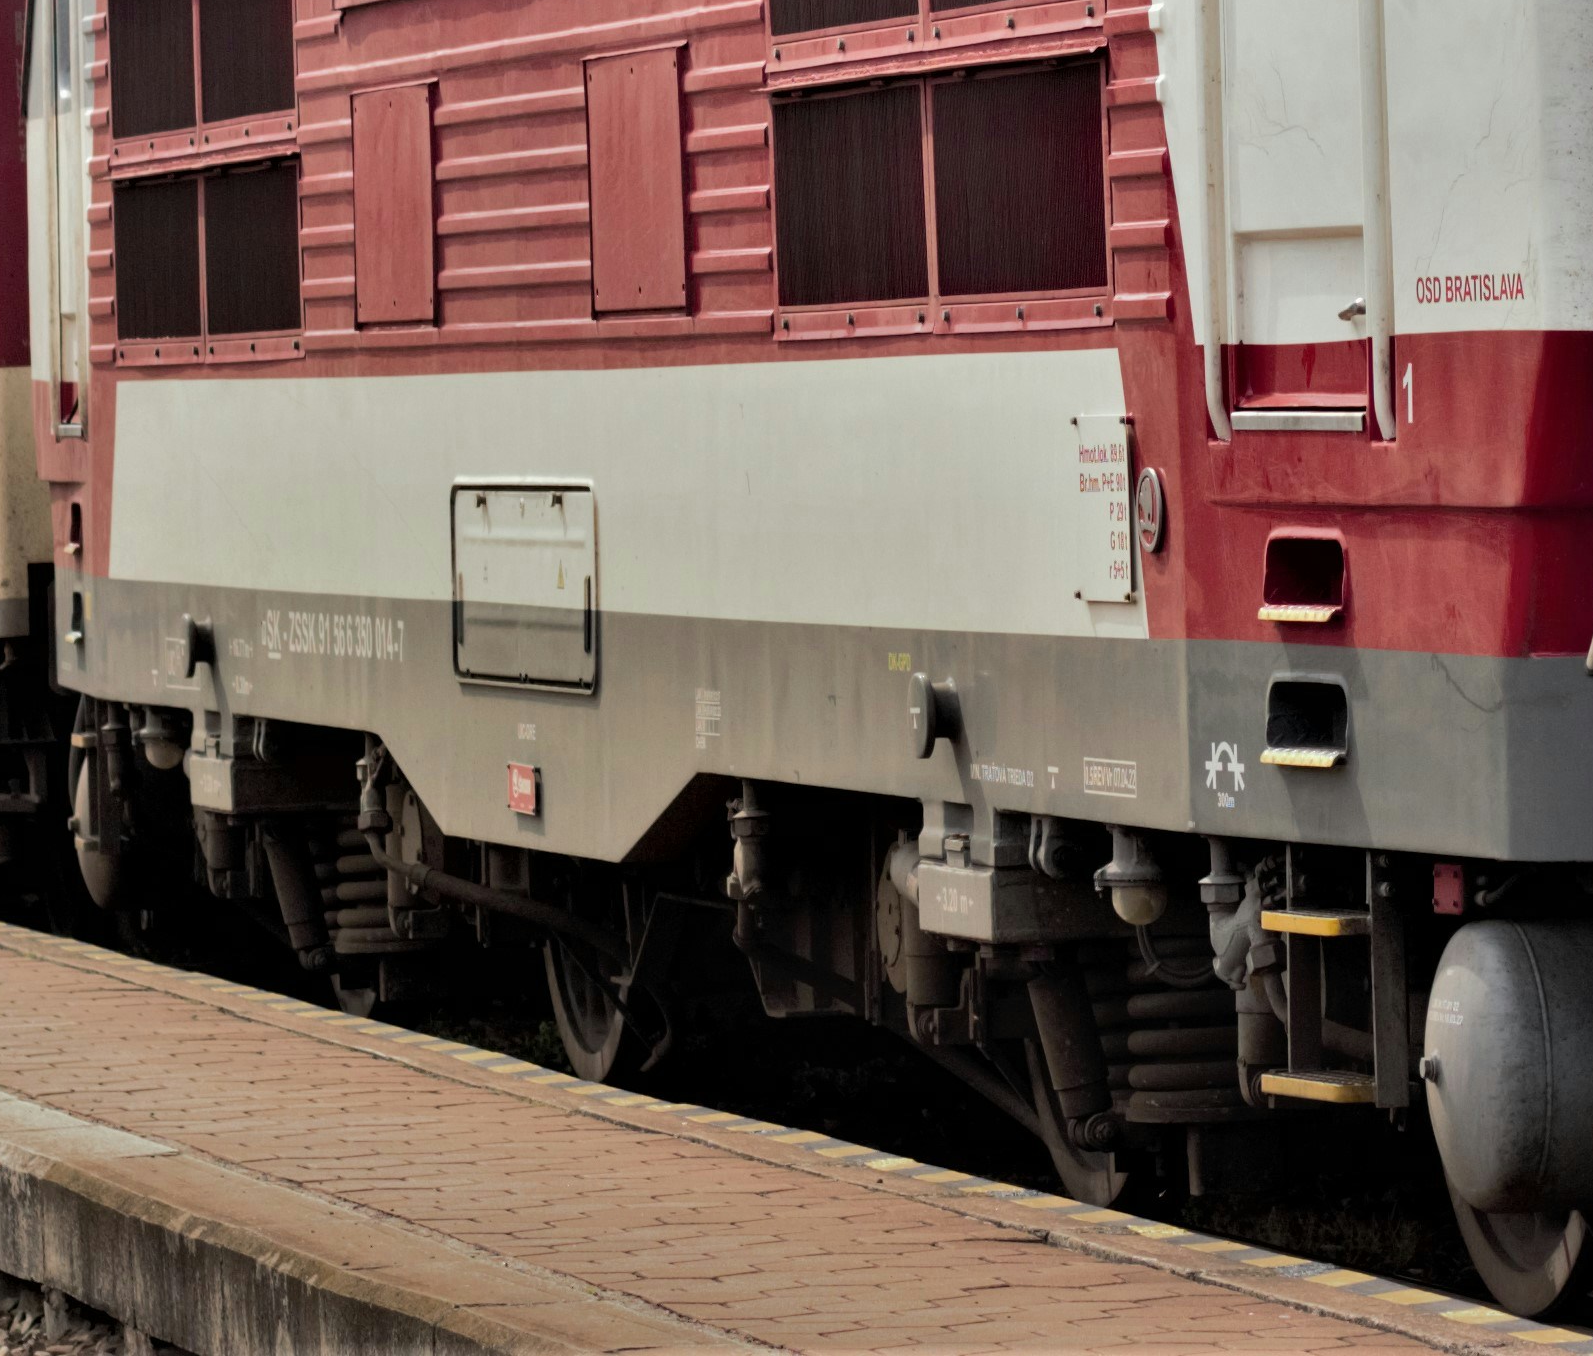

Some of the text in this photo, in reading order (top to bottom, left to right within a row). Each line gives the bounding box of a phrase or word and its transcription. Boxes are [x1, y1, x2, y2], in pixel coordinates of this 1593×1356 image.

[1416, 272, 1525, 304] OSD BRATISLAVA
[1402, 362, 1413, 424] 1
[1109, 502, 1115, 522] P
[1110, 531, 1116, 551] G
[318, 612, 330, 655] 91
[355, 615, 373, 659] 350
[375, 616, 404, 662] 014-7
[1007, 767, 1026, 786] TRIEDA
